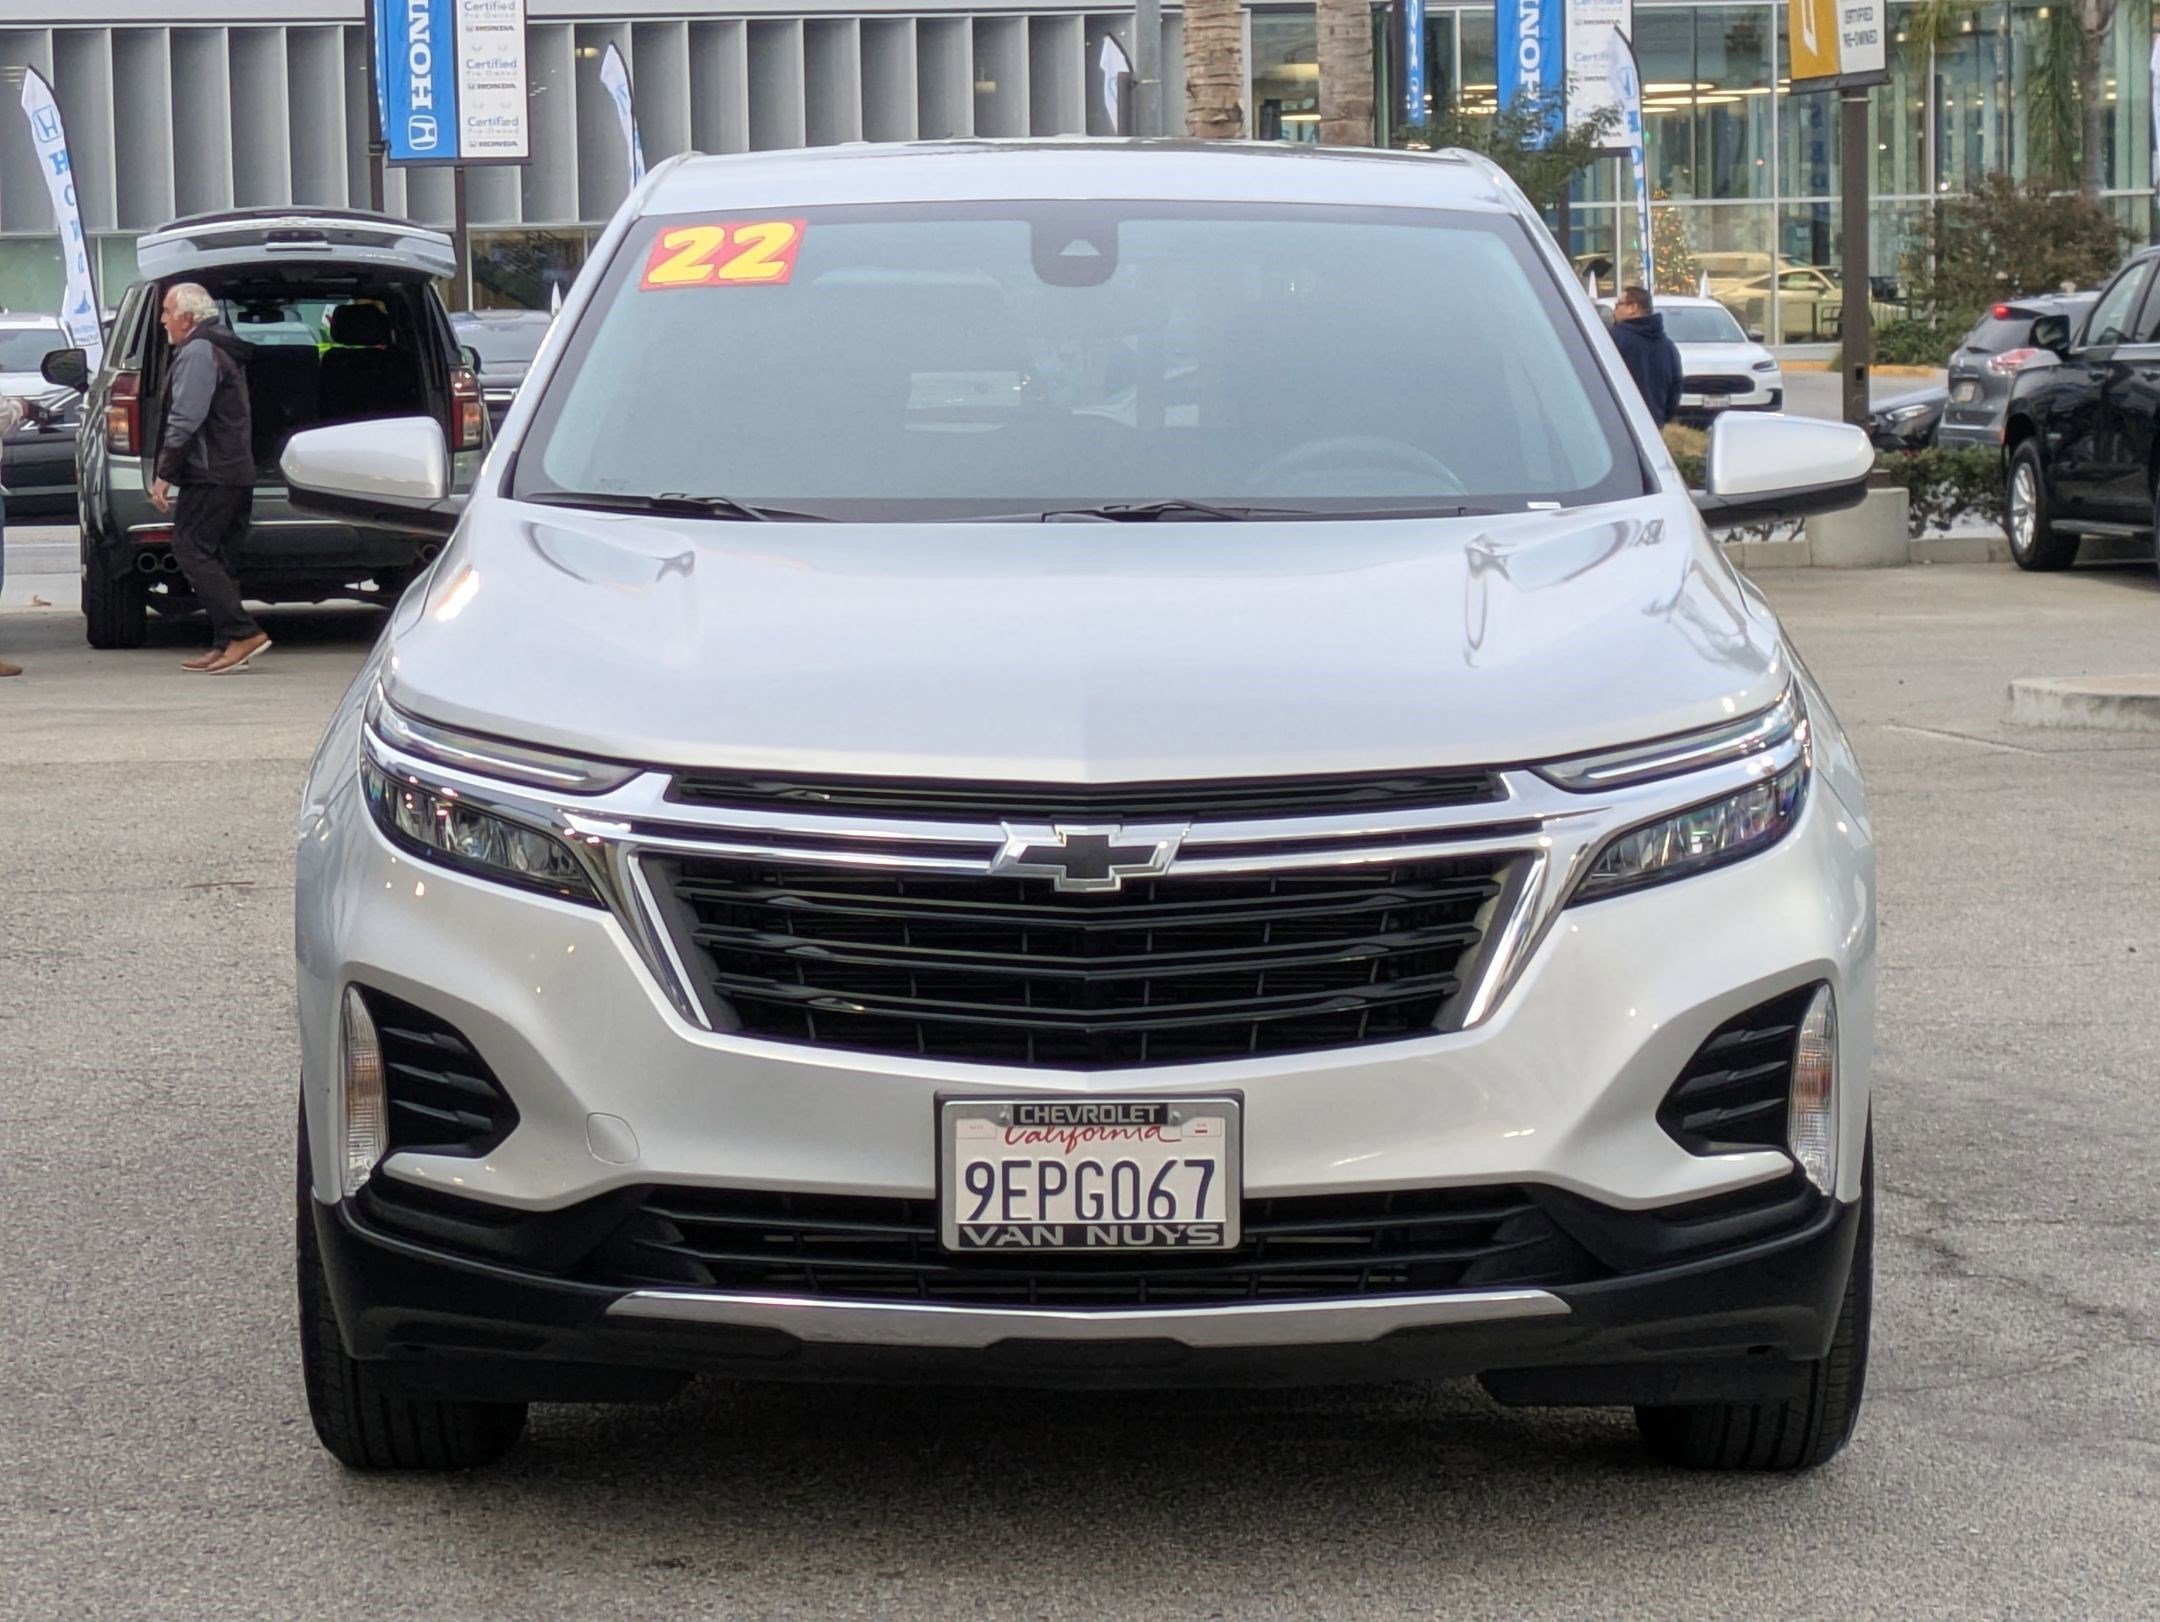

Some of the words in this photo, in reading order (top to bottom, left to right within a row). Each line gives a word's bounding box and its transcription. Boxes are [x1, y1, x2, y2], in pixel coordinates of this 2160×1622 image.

[464, 0, 516, 11] Certified
[466, 59, 517, 70] Certified
[467, 116, 519, 127] Certified
[648, 221, 798, 285] 22
[1019, 1104, 1161, 1124] CHEVROLET
[1004, 1123, 1182, 1155] California
[964, 1158, 1216, 1222] 9EPG067
[962, 1225, 1064, 1247] VAN
[1086, 1224, 1220, 1246] NUYS
